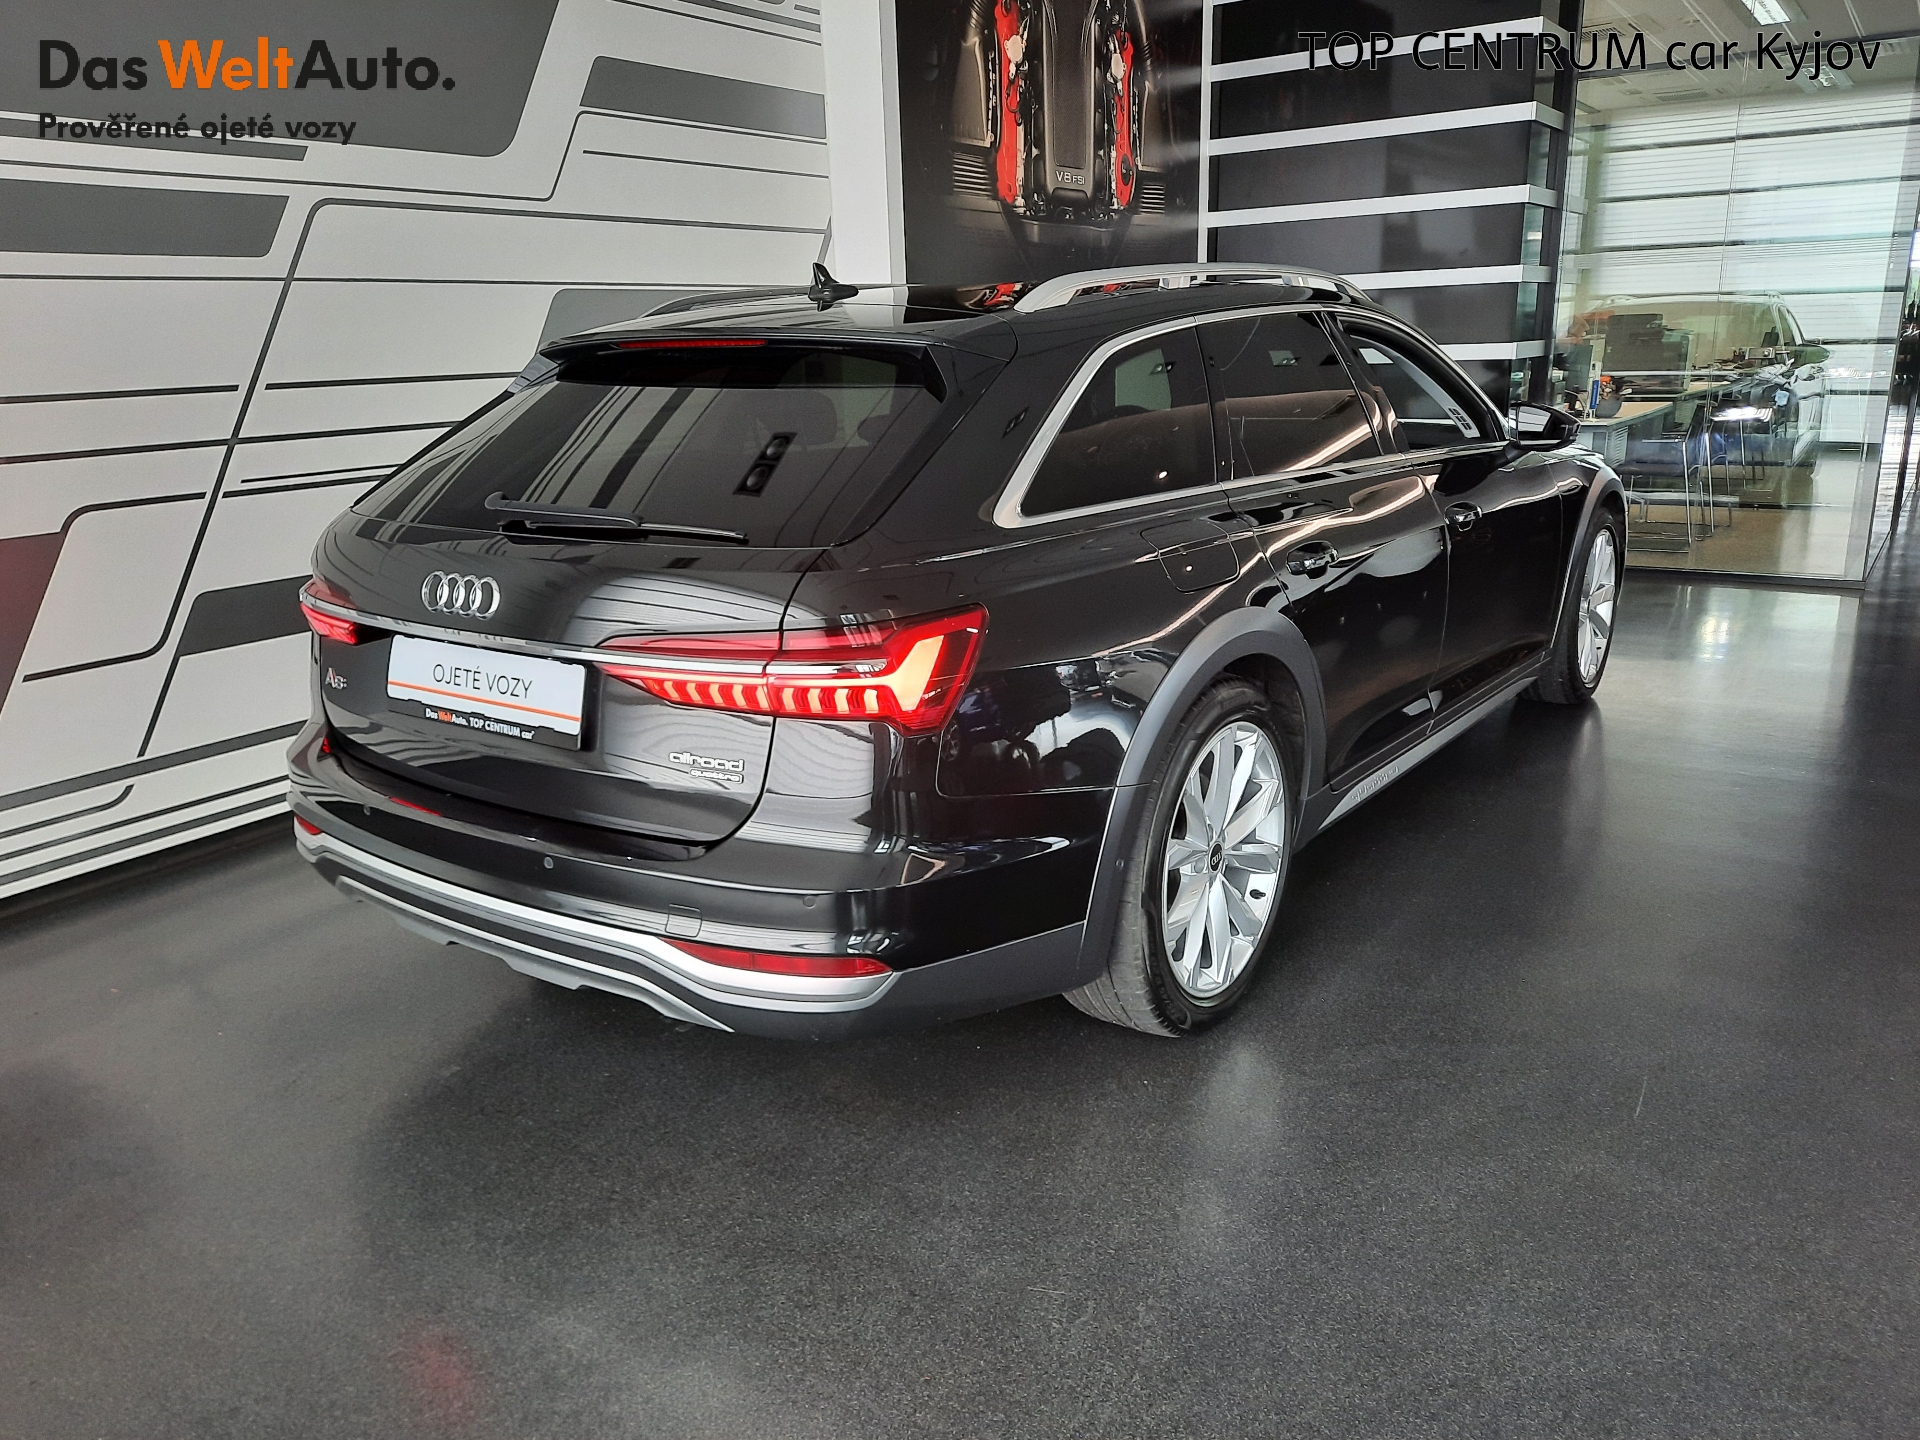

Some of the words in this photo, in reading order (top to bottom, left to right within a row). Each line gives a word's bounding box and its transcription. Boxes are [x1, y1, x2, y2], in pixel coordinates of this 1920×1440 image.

[1056, 170, 1071, 183] V8
[1072, 175, 1085, 185] FSI
[432, 663, 481, 691] OJETÉ
[486, 672, 533, 699] VOZY
[425, 707, 438, 719] Das
[469, 717, 484, 729] TOP
[485, 720, 521, 737] CENTRUM
[669, 751, 744, 772] allroad
[690, 768, 743, 783] quattro
